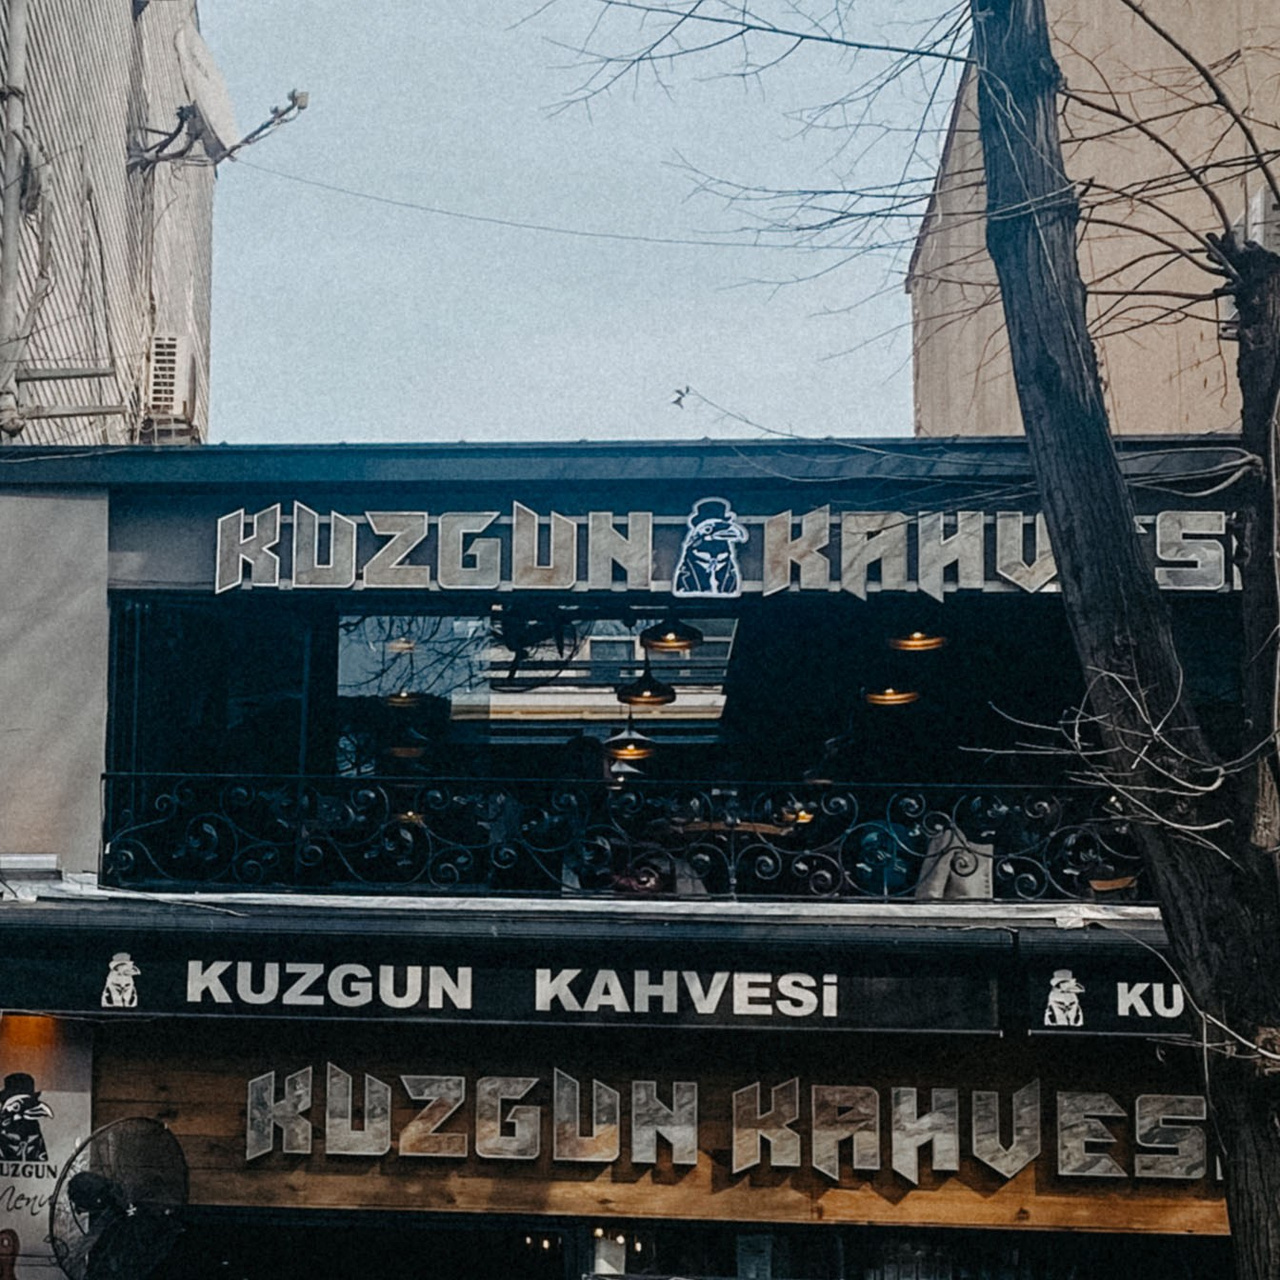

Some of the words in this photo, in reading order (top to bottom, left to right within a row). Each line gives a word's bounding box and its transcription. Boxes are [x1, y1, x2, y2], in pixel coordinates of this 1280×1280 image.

[215, 500, 654, 594] KUZGUN
[763, 506, 1243, 602] KAHVS
[187, 960, 473, 1009] KUZGUN
[1116, 982, 1185, 1018] KU
[246, 1062, 699, 1166] KUZGUN
[733, 1077, 1223, 1185] KAHVES
